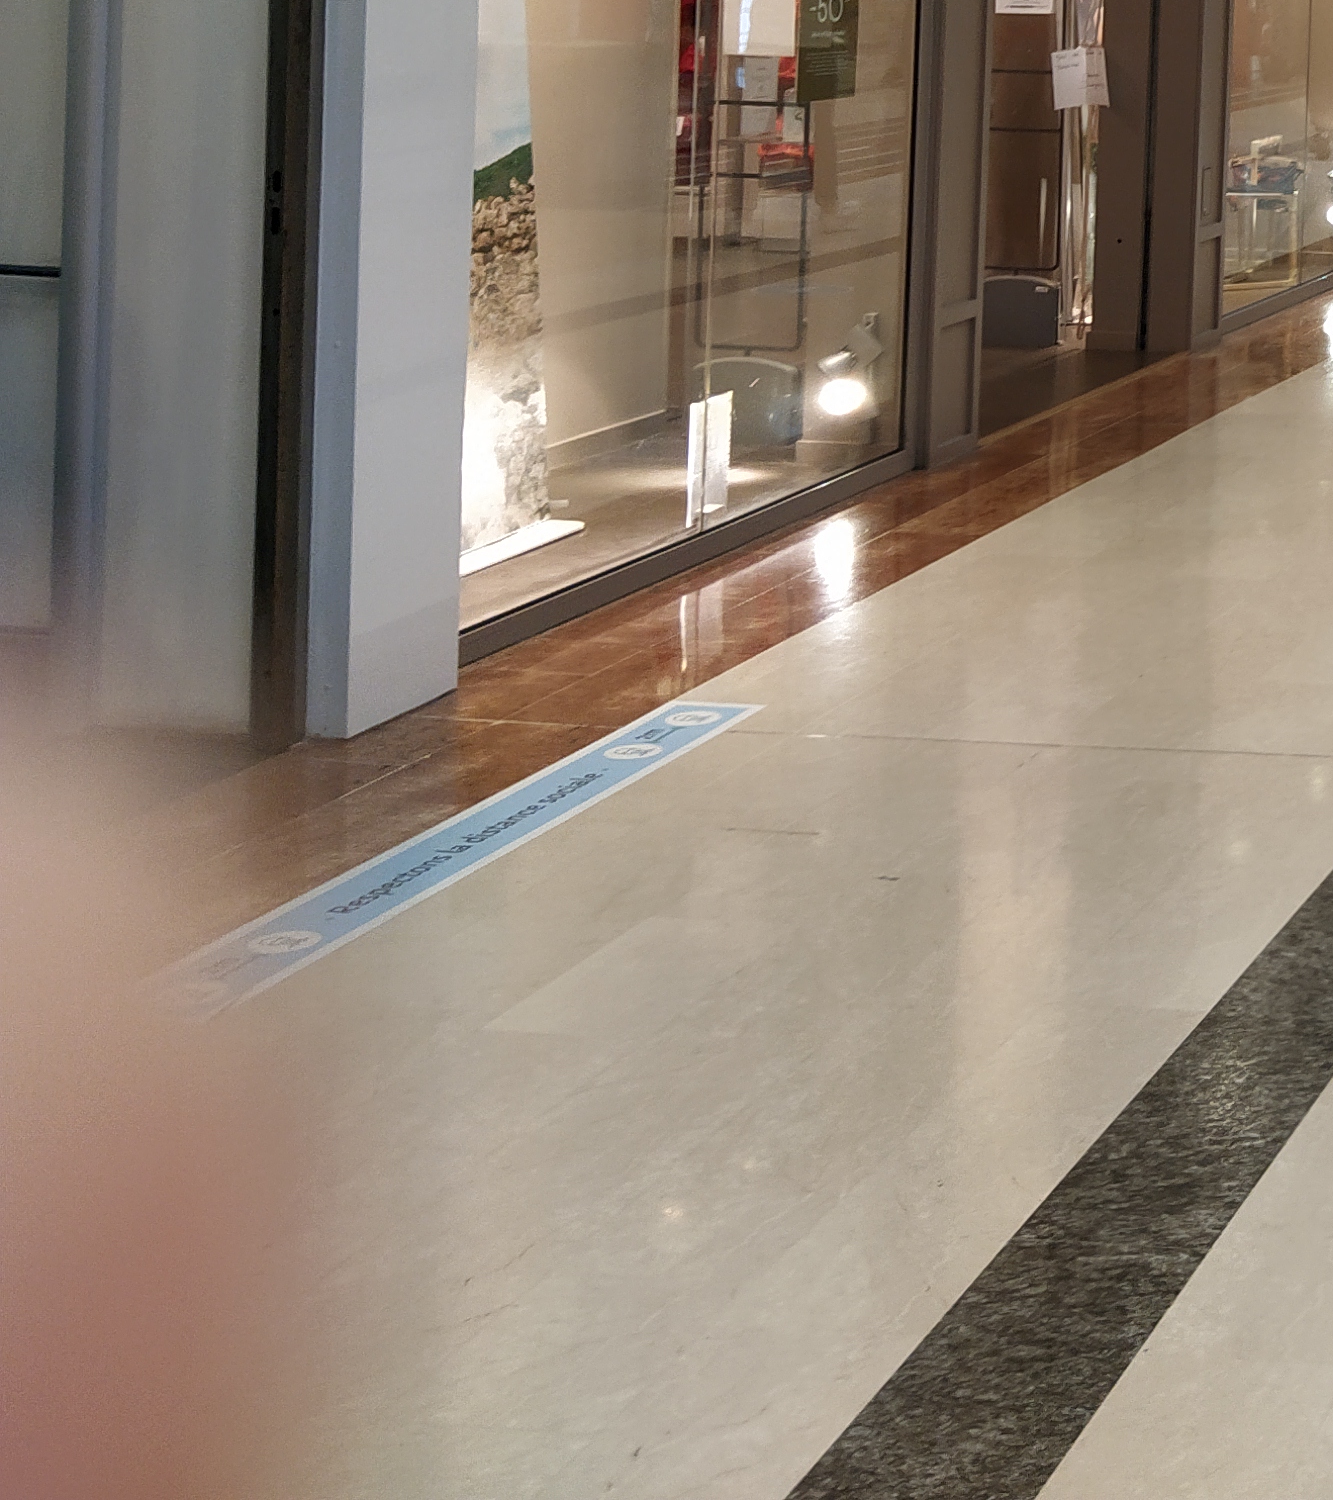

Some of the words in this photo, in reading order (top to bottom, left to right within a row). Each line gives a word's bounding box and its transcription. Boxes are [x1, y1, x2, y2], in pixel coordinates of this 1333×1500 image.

[326, 854, 453, 914] Respectons
[434, 844, 474, 854] la
[462, 803, 547, 844] distance
[537, 772, 603, 804] sociale
